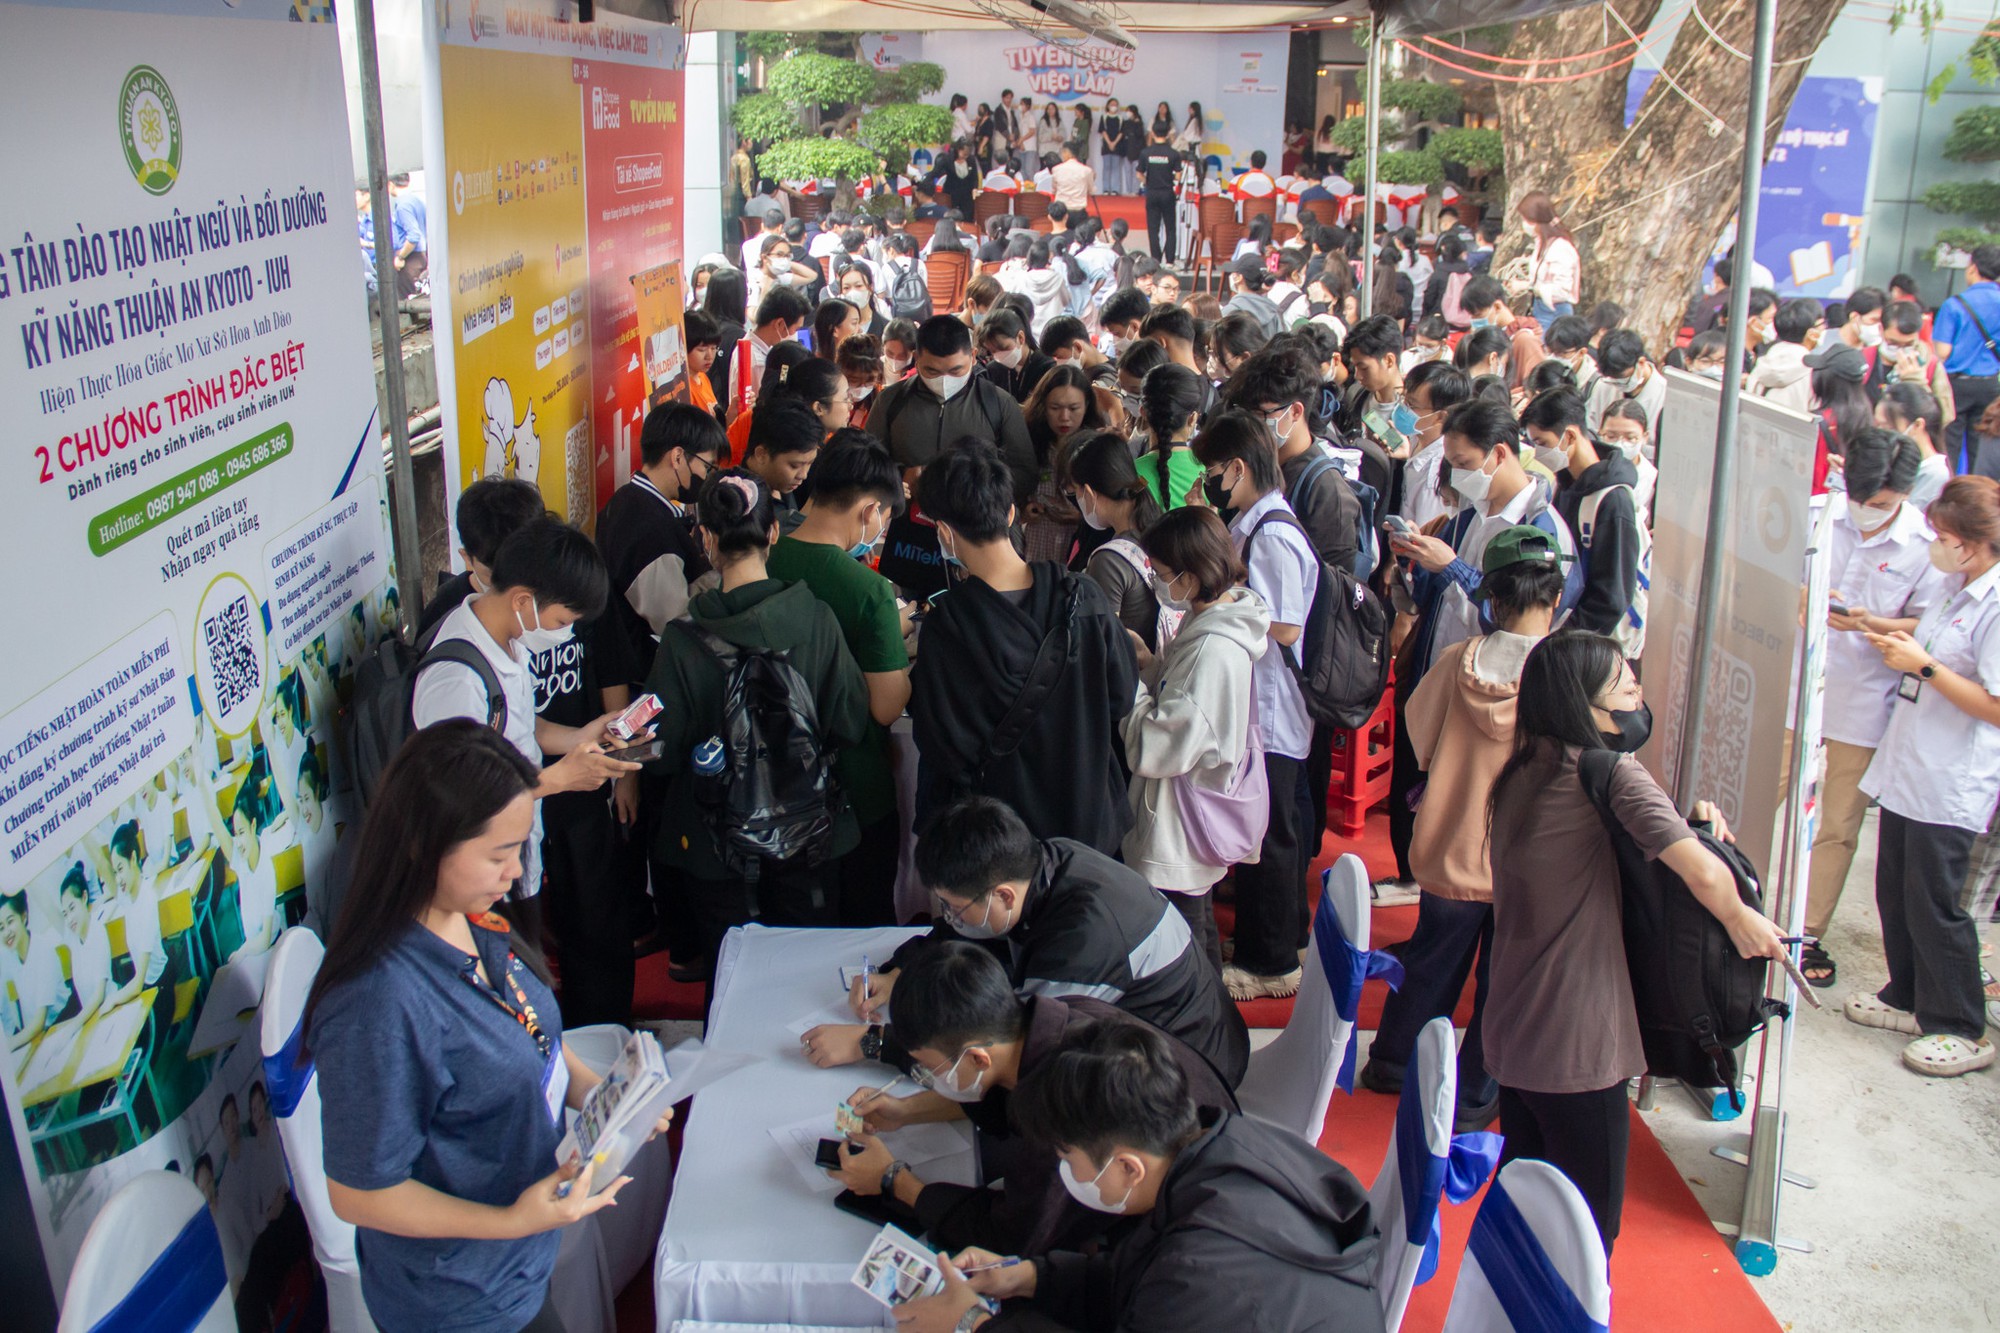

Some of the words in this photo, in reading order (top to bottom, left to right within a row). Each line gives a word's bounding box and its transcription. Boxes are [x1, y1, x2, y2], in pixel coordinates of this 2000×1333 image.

[153, 81, 177, 133] KYOTO
[603, 106, 620, 129] Food
[1028, 70, 1071, 96] VIỆC
[1073, 70, 1114, 97] LÀM
[10, 231, 61, 294] TÂM
[63, 223, 107, 283] ĐÀO
[108, 225, 147, 279] TẠO
[149, 207, 193, 266] NHẬT
[196, 199, 230, 252] NGỮ
[232, 194, 254, 243] VÀ
[254, 188, 280, 239] BỒI
[281, 185, 327, 232] DƯỠNG
[21, 307, 51, 369] KỸ
[55, 299, 114, 359] NĂNG
[114, 278, 177, 340] THUẬN
[181, 279, 203, 321] AN
[204, 265, 253, 313] KYOTO
[265, 255, 291, 294] IUH
[34, 446, 54, 484] 2
[57, 401, 162, 472] CHƯƠNG
[164, 374, 226, 426] TRÌNH
[229, 355, 268, 400] ĐẶC
[270, 339, 305, 382] BIỆT
[40, 386, 76, 415] Hiện
[78, 373, 112, 400] Thực
[115, 362, 142, 387] Hóa
[145, 347, 173, 376] Giấc
[176, 342, 194, 365] Mơ
[229, 325, 250, 346] Hoa
[253, 315, 272, 337] Anh
[68, 473, 102, 501] Dành
[105, 458, 137, 483] riêng
[140, 449, 161, 467] cho
[164, 434, 187, 456] sinh
[189, 424, 215, 444] viên,
[217, 414, 235, 432] cựu
[237, 402, 257, 422] sinh
[258, 394, 278, 411] viên
[279, 384, 295, 402] IUH
[99, 511, 144, 545] Hotline:
[146, 490, 175, 520] 0987
[176, 479, 197, 504] 947
[198, 468, 219, 492] 088
[226, 451, 251, 478] 0945
[252, 442, 270, 465] 686
[270, 433, 288, 455] 366
[161, 555, 191, 583] Nhận
[193, 539, 216, 565] ngay
[219, 523, 238, 551] quà
[238, 513, 260, 538] tặng
[166, 525, 193, 556] Quét
[195, 515, 211, 537] mã
[211, 505, 232, 528] liền
[233, 497, 248, 516] tay
[271, 542, 298, 569] CHƯƠNG
[297, 531, 317, 551] TRÌNH
[894, 541, 941, 566] MiTek
[274, 570, 291, 590] SINH
[0, 749, 16, 774] ỌC
[15, 726, 49, 760] TIẾNG
[49, 705, 77, 736] NHẬT
[77, 687, 106, 716] HOÀN
[105, 668, 131, 695] TOÀN
[130, 650, 154, 678] MIỄN
[154, 637, 170, 662] PHÍ
[0, 780, 18, 807] Khi
[18, 765, 45, 791] đăng
[44, 750, 58, 772] ký
[58, 728, 94, 761] chương
[93, 709, 117, 735] trình
[129, 692, 140, 710] sư
[139, 677, 160, 698] Nhật
[159, 667, 176, 686] Bản
[4, 797, 45, 834] Chương
[45, 775, 71, 804] trình
[70, 762, 90, 783] học
[105, 732, 132, 752] Tiếng
[130, 713, 152, 738] Nhật
[151, 708, 158, 721] 2
[157, 695, 176, 717] tuần
[9, 830, 41, 864] MIỄN
[40, 810, 61, 839] PHÍ
[61, 801, 77, 822] với
[76, 791, 93, 811] lớp
[92, 772, 119, 797] Tiếng
[118, 752, 140, 777] Nhật
[140, 741, 154, 759] đại
[153, 729, 166, 749] trà
